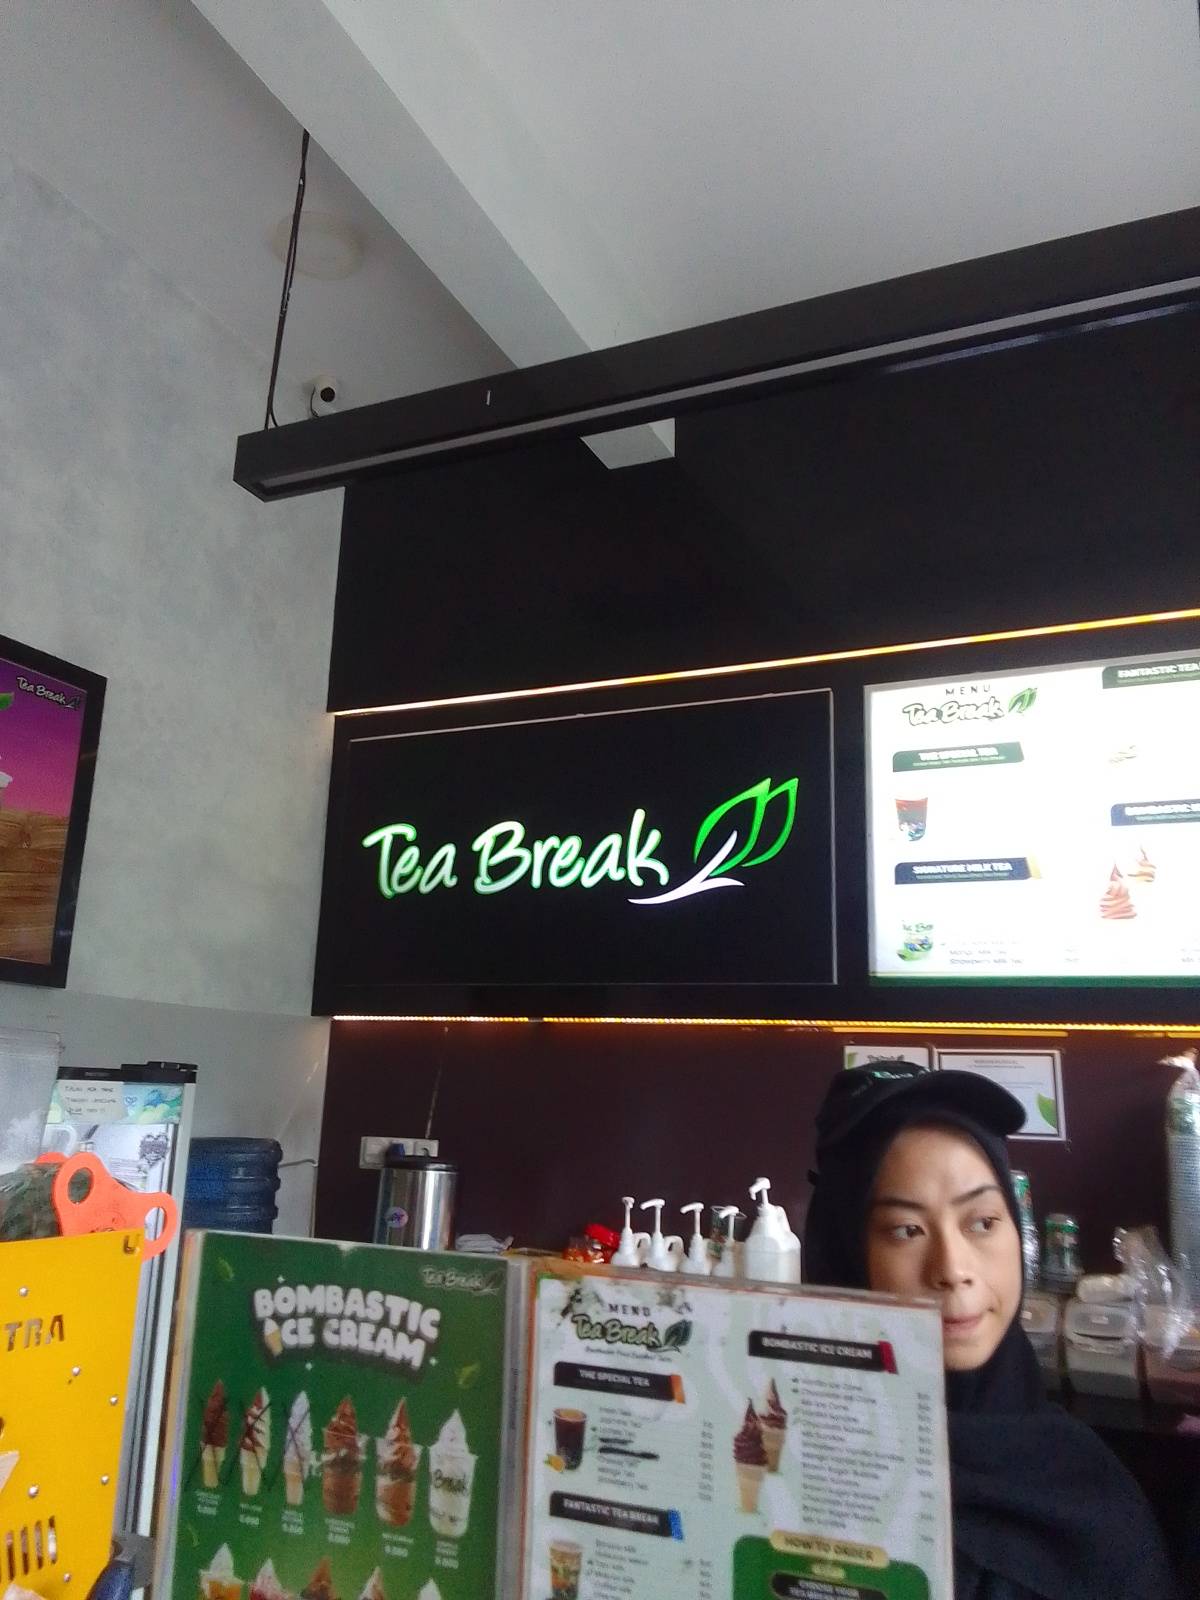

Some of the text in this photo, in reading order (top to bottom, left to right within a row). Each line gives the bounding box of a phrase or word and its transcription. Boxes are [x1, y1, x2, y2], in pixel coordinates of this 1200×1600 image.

[17, 677, 66, 705] Tea Break
[945, 684, 991, 696] MENU
[362, 808, 670, 899] Tea Break
[253, 1284, 442, 1341] BOMBASTIC
[608, 1303, 652, 1317] MENU
[322, 1318, 426, 1370] CREAM
[571, 1313, 663, 1348] Tea Break
